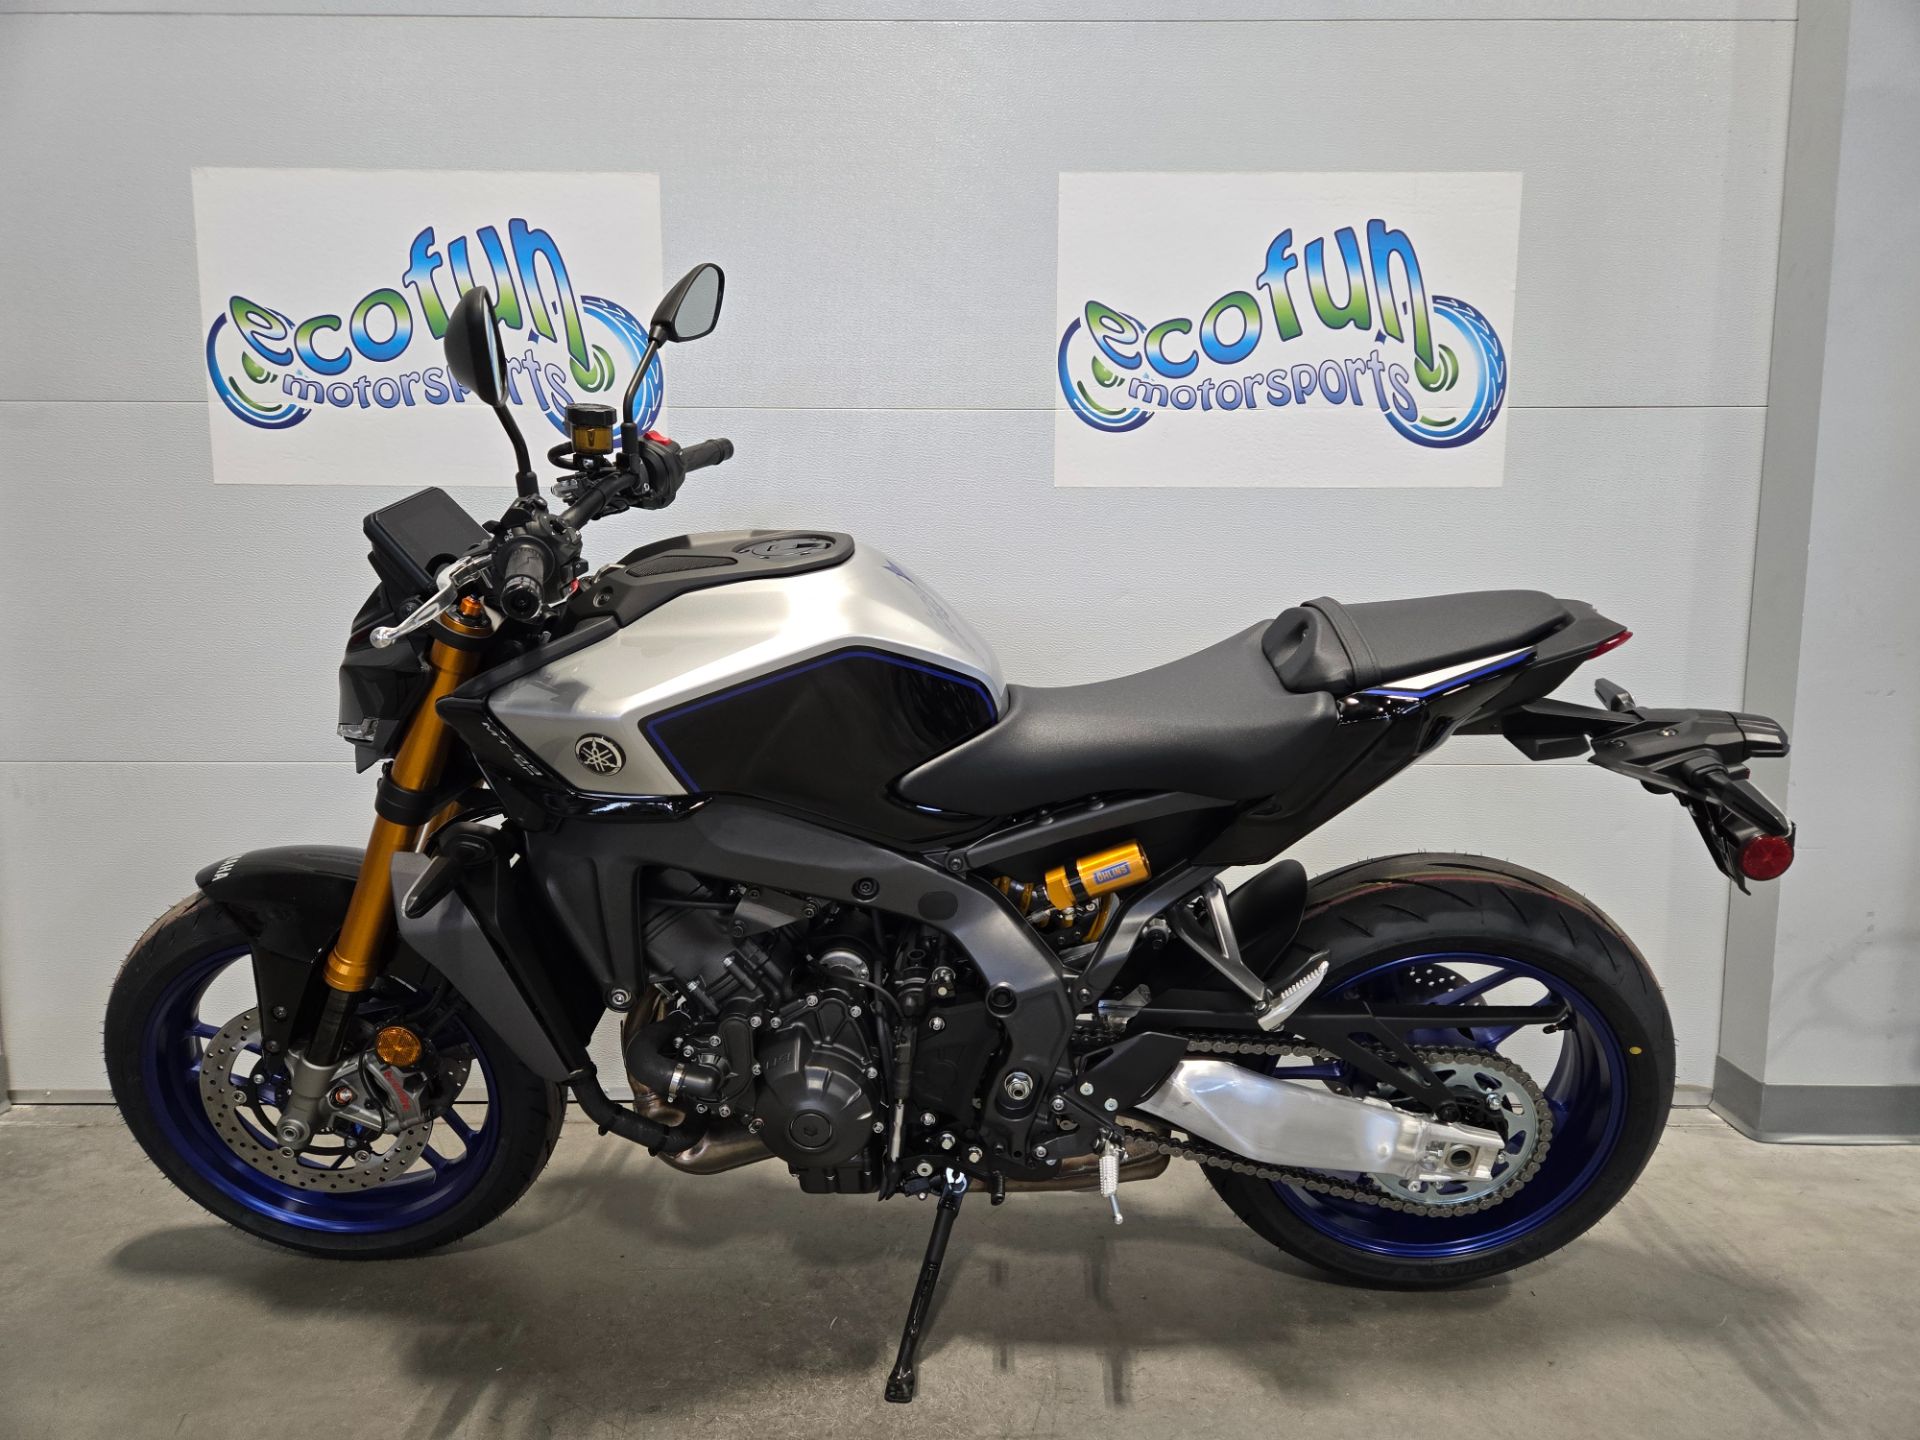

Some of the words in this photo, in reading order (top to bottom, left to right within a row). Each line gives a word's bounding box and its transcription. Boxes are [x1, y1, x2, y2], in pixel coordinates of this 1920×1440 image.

[229, 218, 591, 375] ecofun
[1085, 218, 1435, 379] ecofun
[282, 349, 575, 419] motorsprts
[1128, 349, 1420, 423] motorsports
